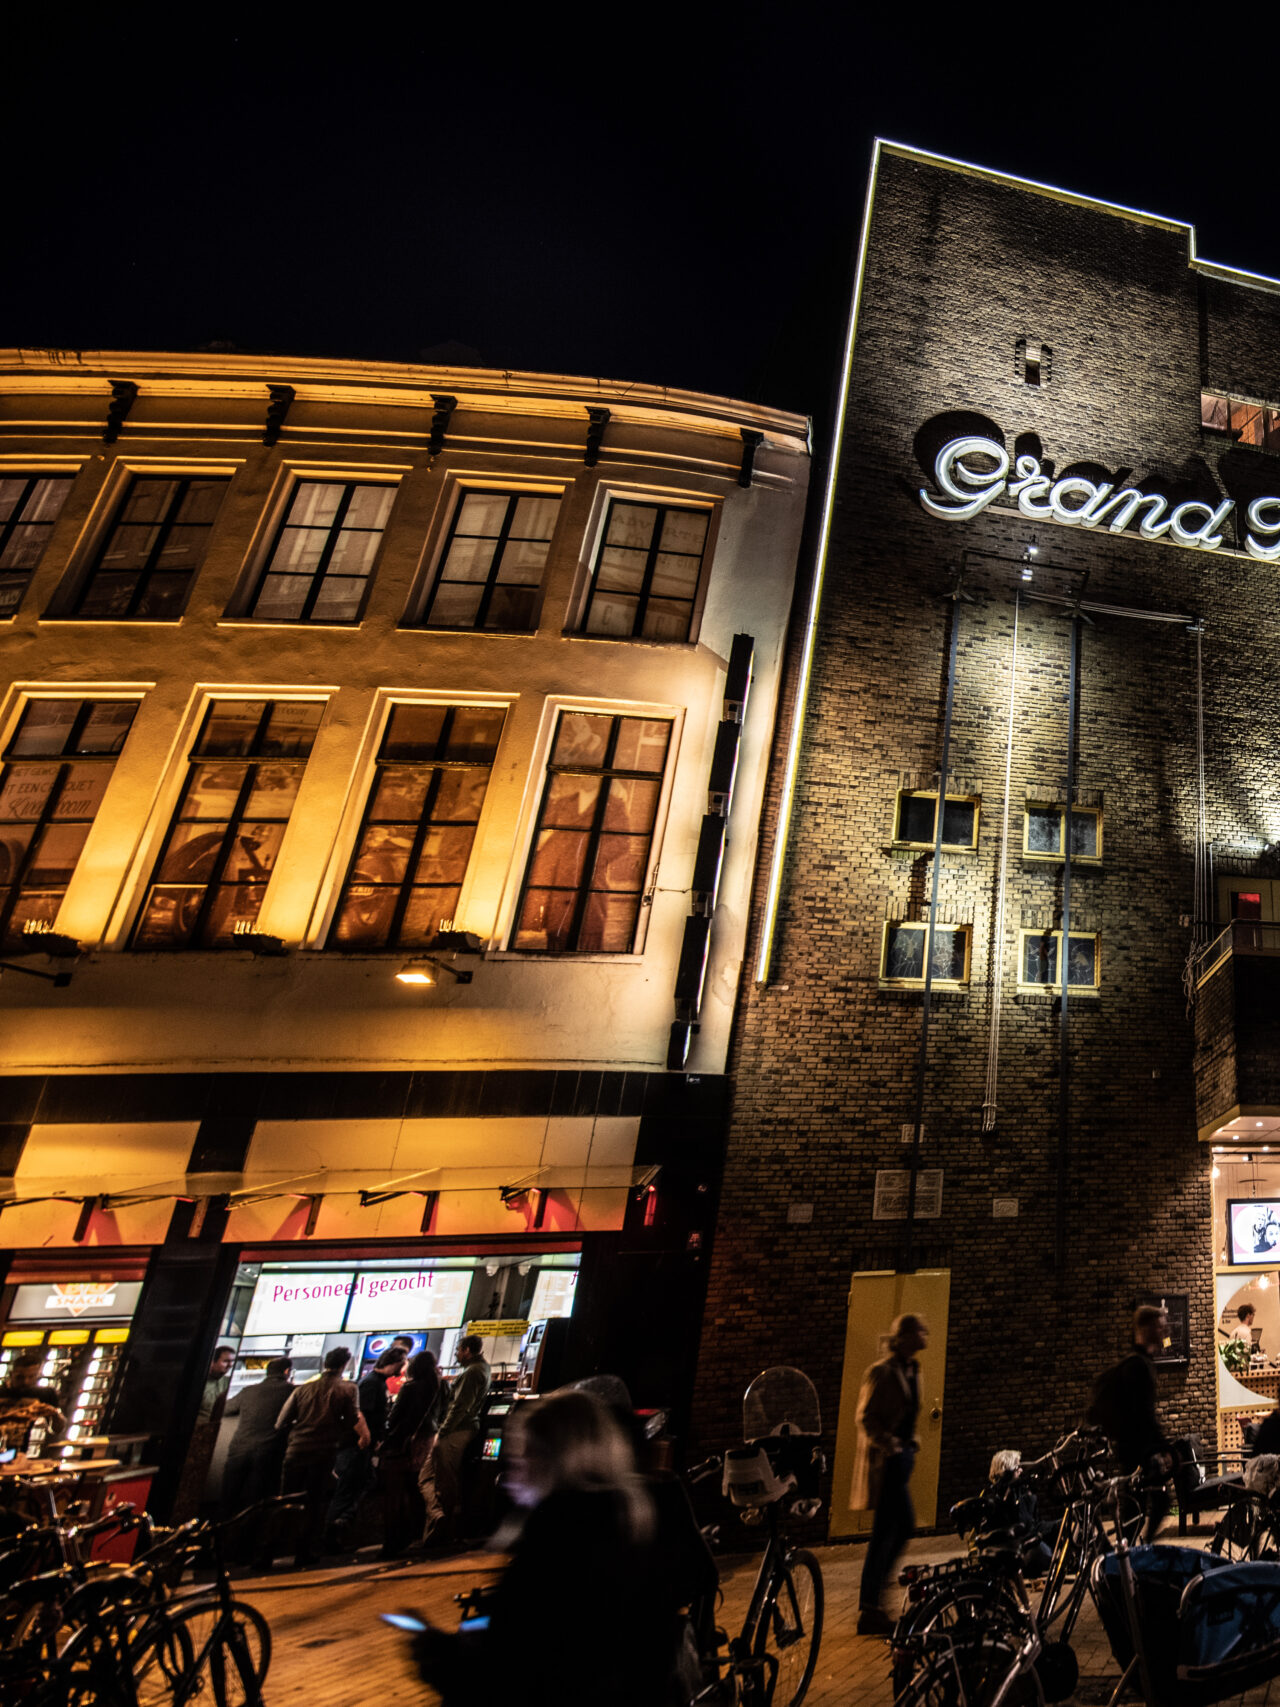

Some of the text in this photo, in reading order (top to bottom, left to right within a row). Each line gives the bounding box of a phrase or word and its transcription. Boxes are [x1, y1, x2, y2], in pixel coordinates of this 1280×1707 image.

[920, 436, 1235, 549] Grand
[273, 1271, 435, 1302] Personeel gezocht
